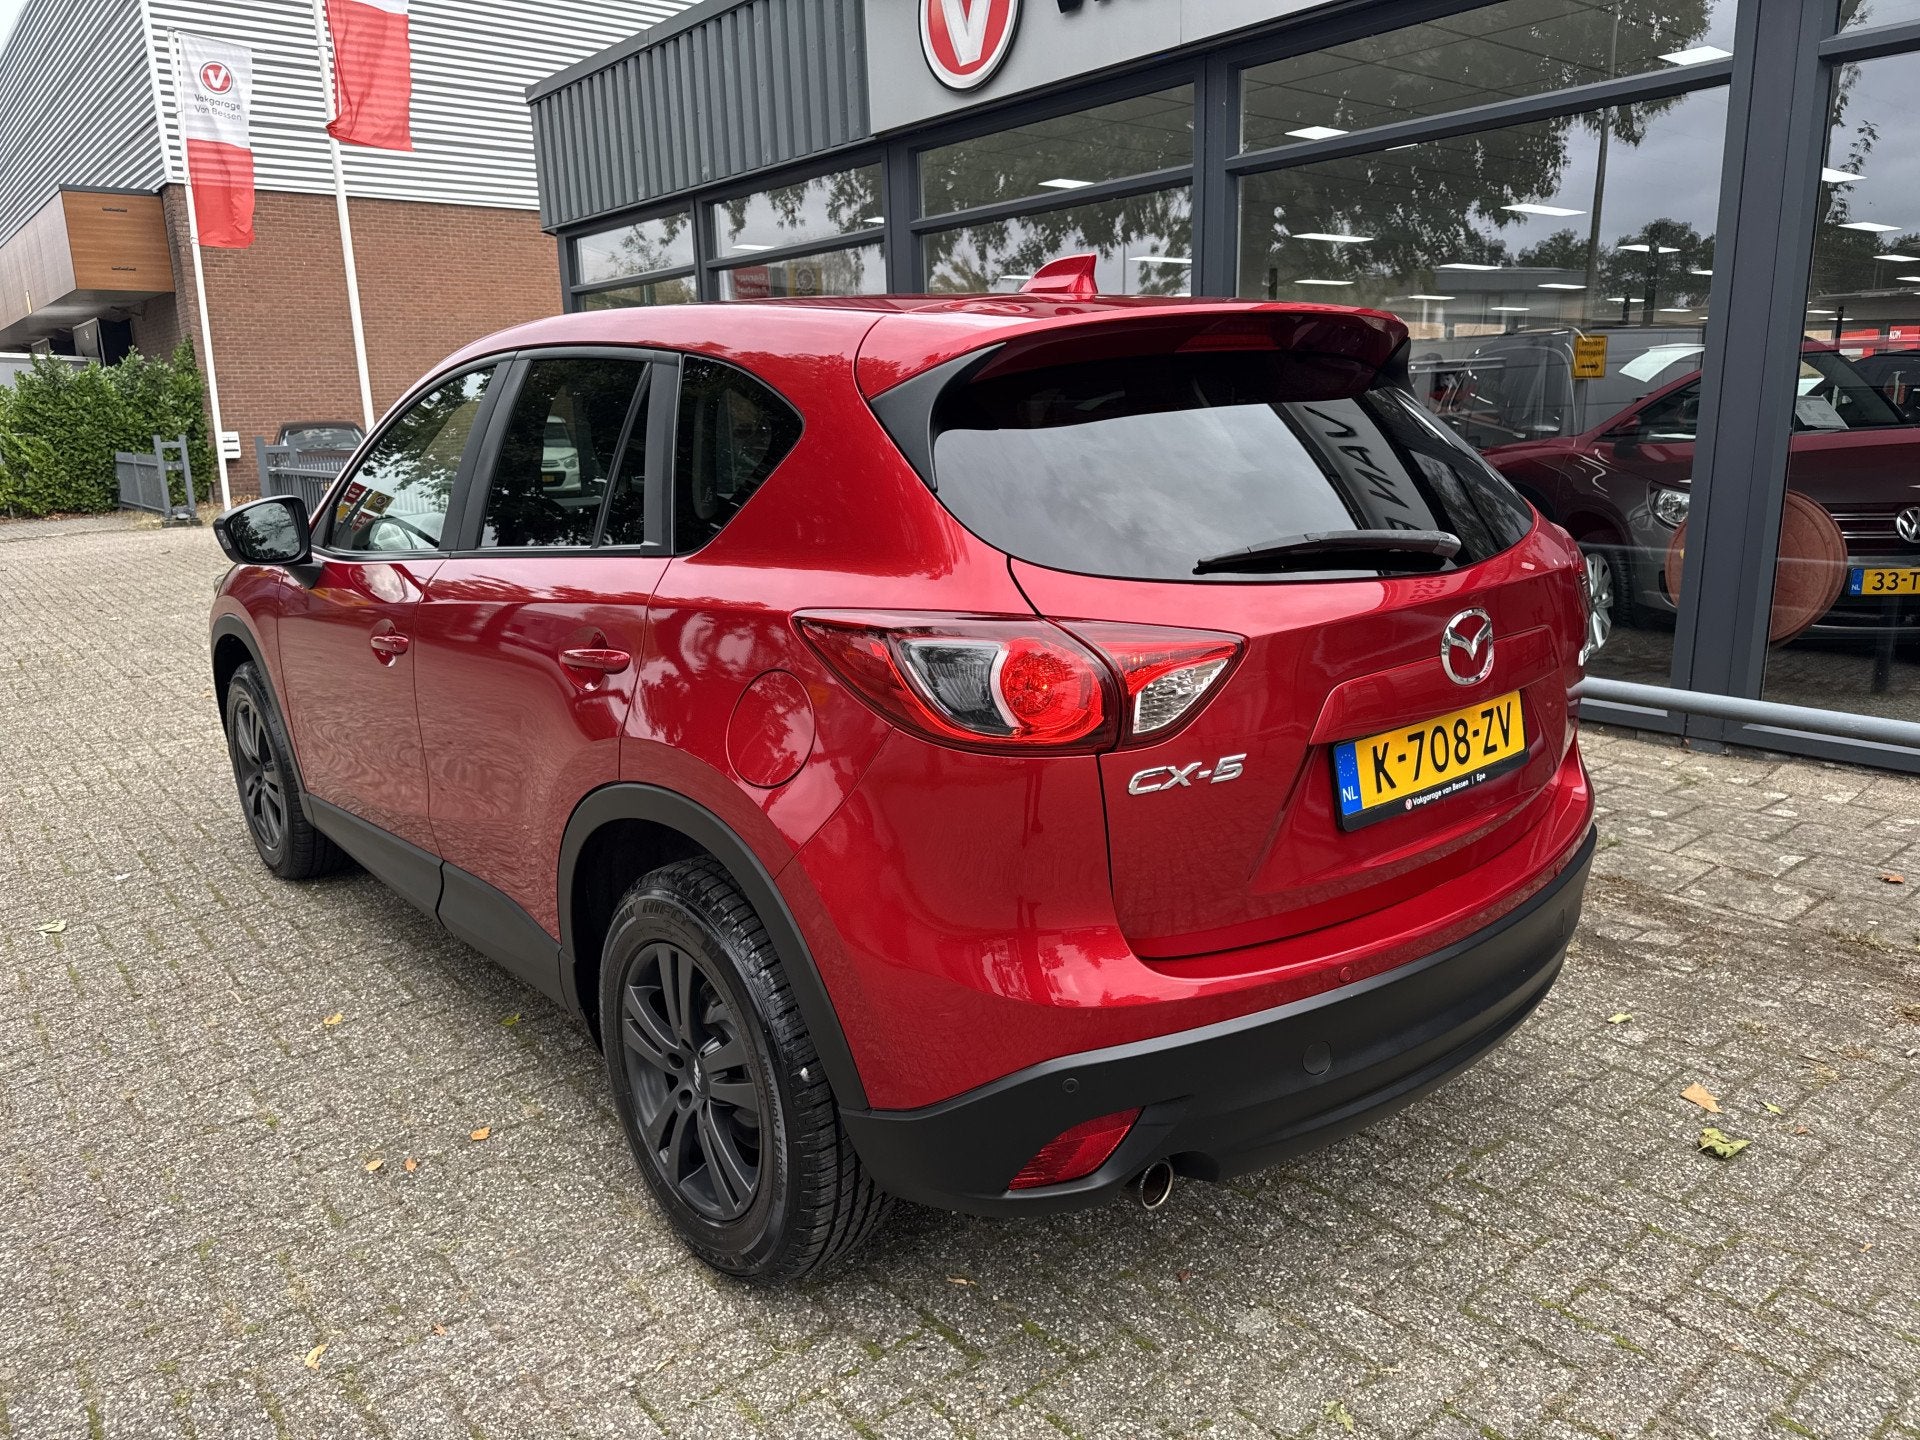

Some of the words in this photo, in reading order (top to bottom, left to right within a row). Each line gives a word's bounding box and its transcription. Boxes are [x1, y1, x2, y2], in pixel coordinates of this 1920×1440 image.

[194, 93, 241, 111] Vakgarage
[194, 104, 210, 114] Van
[211, 107, 242, 121] Bessen
[1372, 702, 1511, 793] K-708-ZV
[1128, 752, 1247, 796] CX-5
[1342, 786, 1359, 803] NL
[1413, 791, 1441, 805] Vakgarage
[1452, 779, 1469, 791] Bessen
[1476, 773, 1486, 782] Epe
